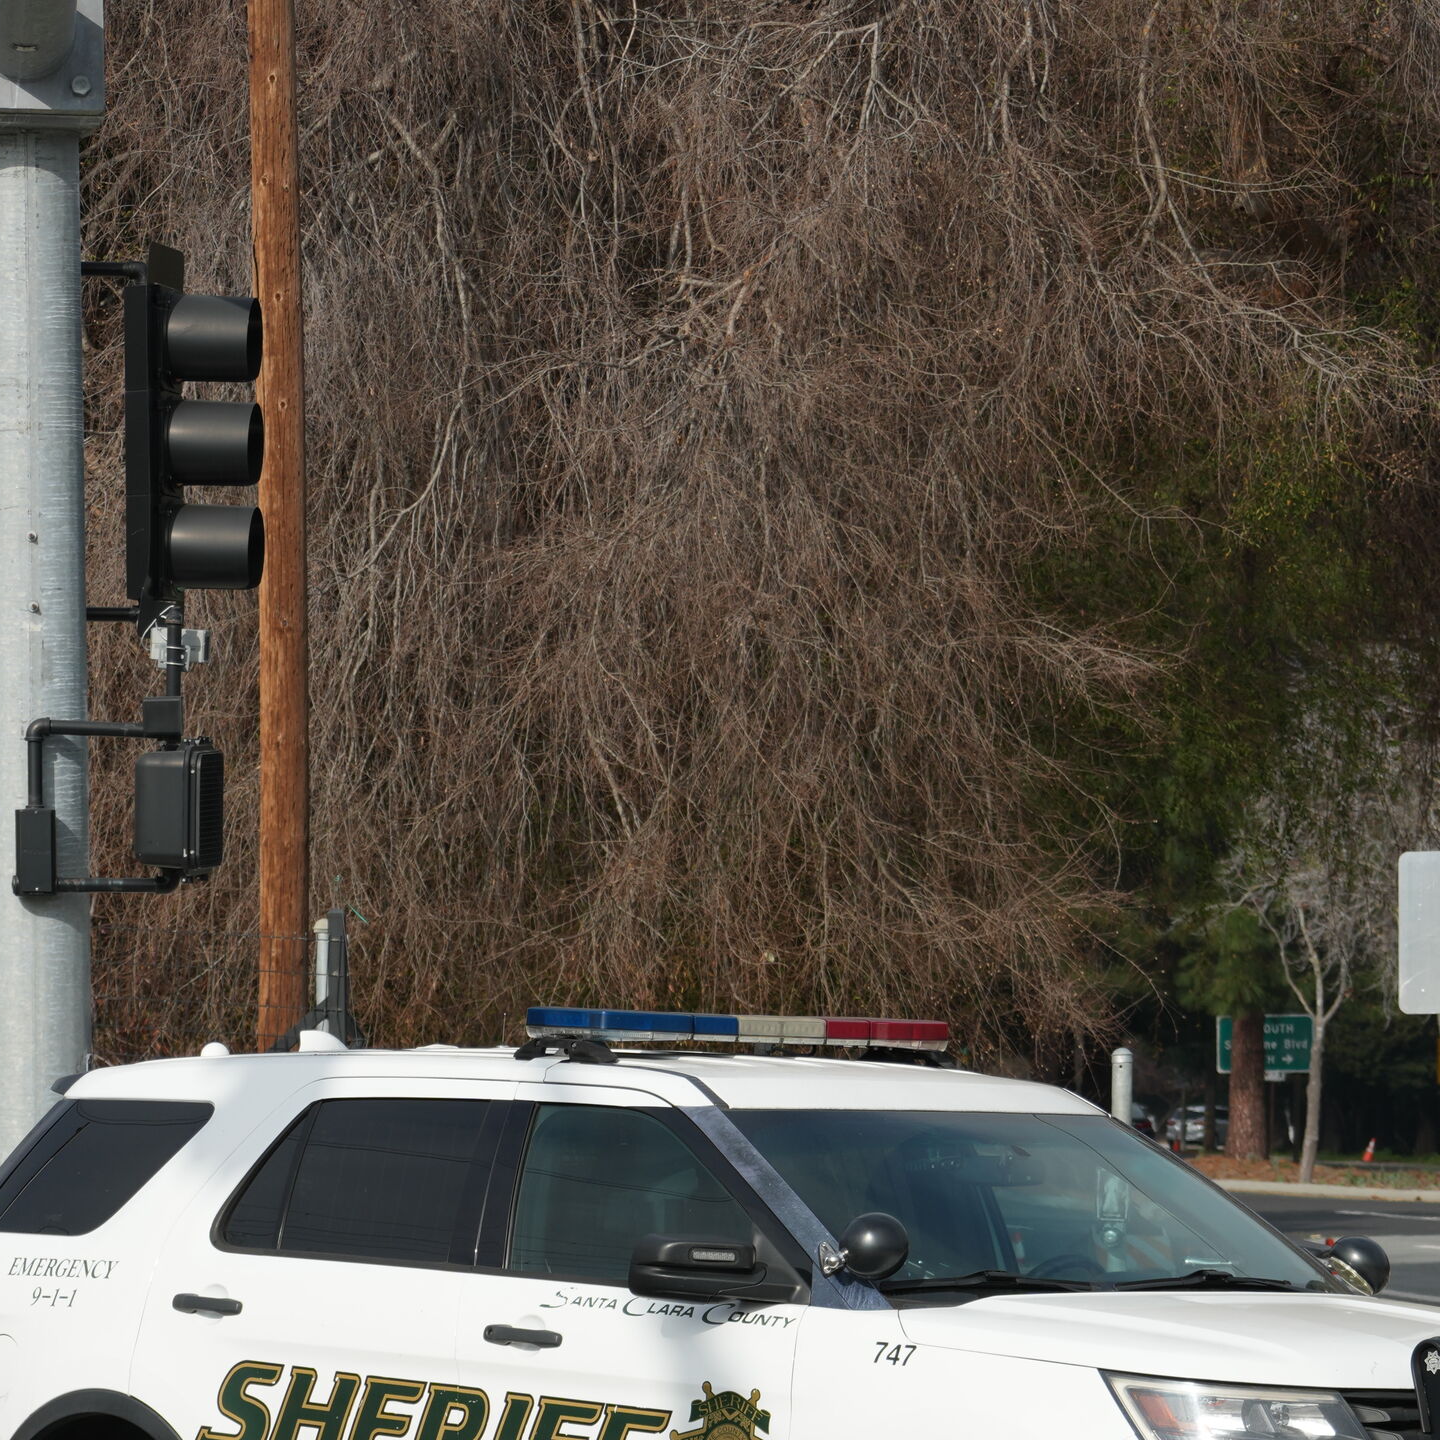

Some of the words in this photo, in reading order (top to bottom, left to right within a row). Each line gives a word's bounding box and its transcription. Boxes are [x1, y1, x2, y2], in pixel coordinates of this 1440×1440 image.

[1263, 1023, 1295, 1034] OUTH
[1283, 1039, 1308, 1049] Blvd
[7, 1256, 120, 1279] EMERGENCY
[30, 1286, 78, 1308] 9-1-1
[622, 1296, 694, 1318] CLARA
[701, 1303, 797, 1329] COUNTY
[873, 1341, 917, 1367] 747
[698, 1393, 764, 1423] SHERIFF
[717, 1426, 745, 1440] COUNTY
